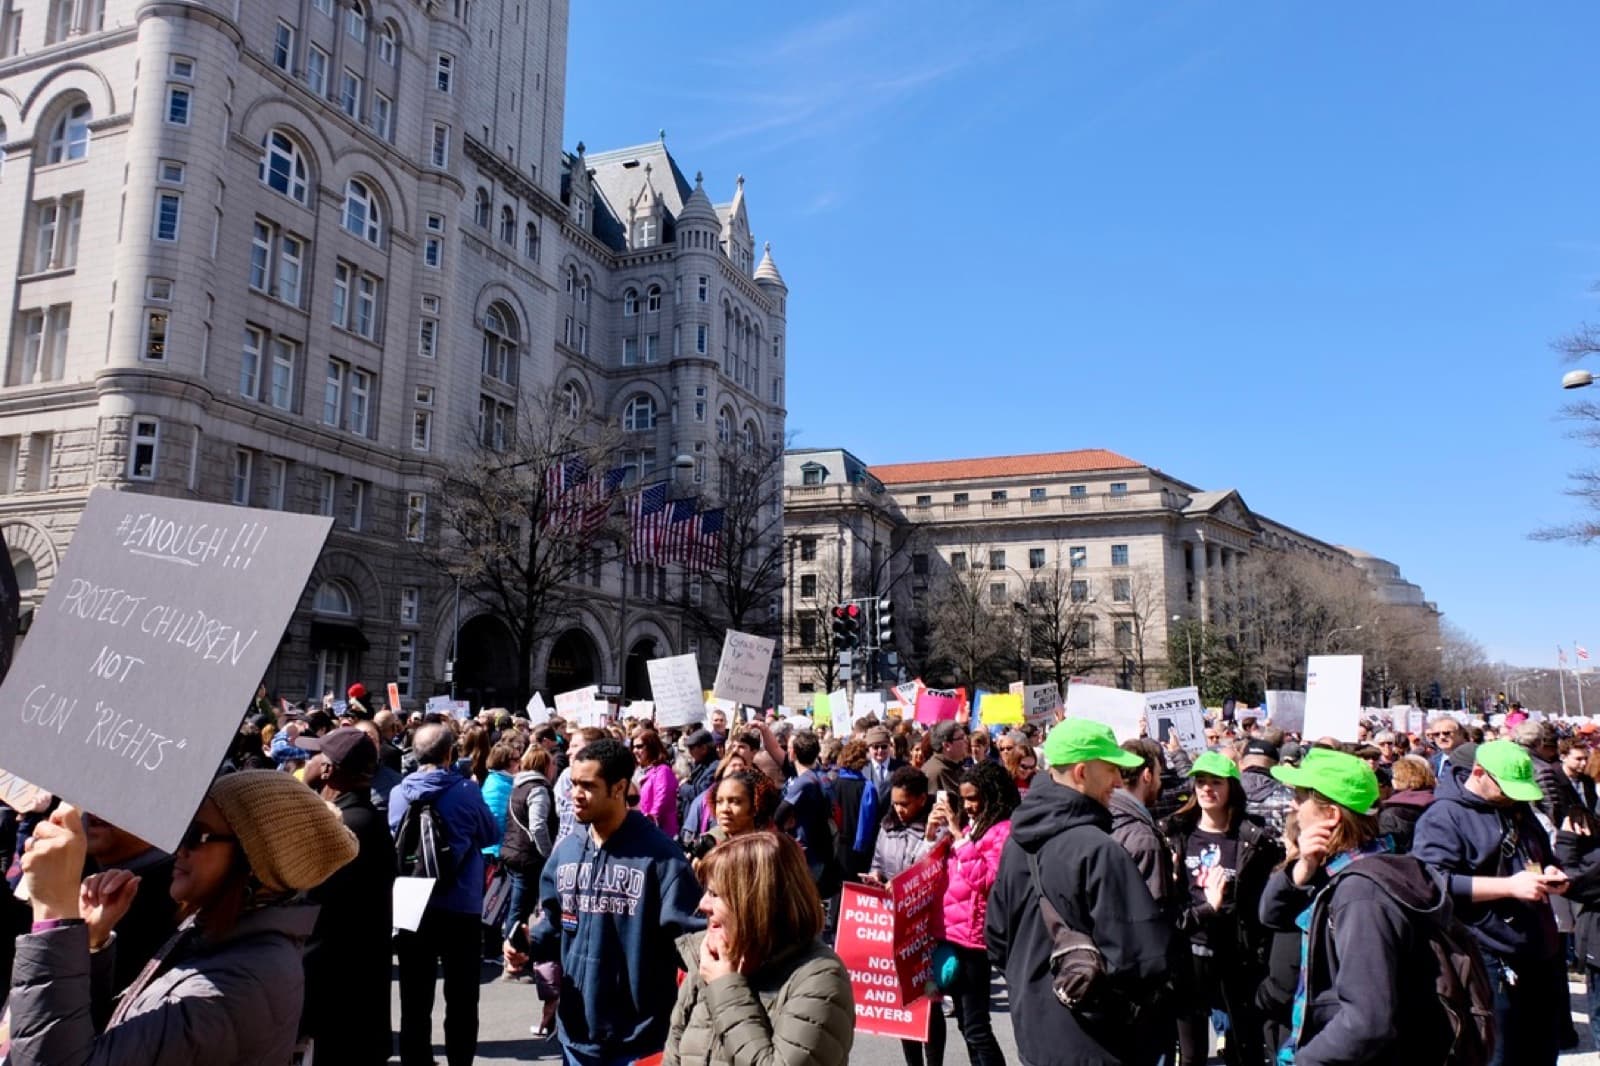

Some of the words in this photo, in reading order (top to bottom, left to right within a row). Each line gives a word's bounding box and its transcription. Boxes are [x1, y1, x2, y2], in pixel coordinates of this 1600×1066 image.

[59, 578, 147, 627] PROTECT
[141, 605, 257, 667] CHILDREN
[89, 645, 145, 683] NOT
[21, 684, 78, 735] GUN
[1149, 698, 1196, 711] WANTED
[902, 874, 920, 893] WE
[921, 857, 944, 881] WAN
[856, 895, 879, 909] WE
[864, 988, 897, 1004] AND
[854, 1003, 913, 1023] RAYERS
